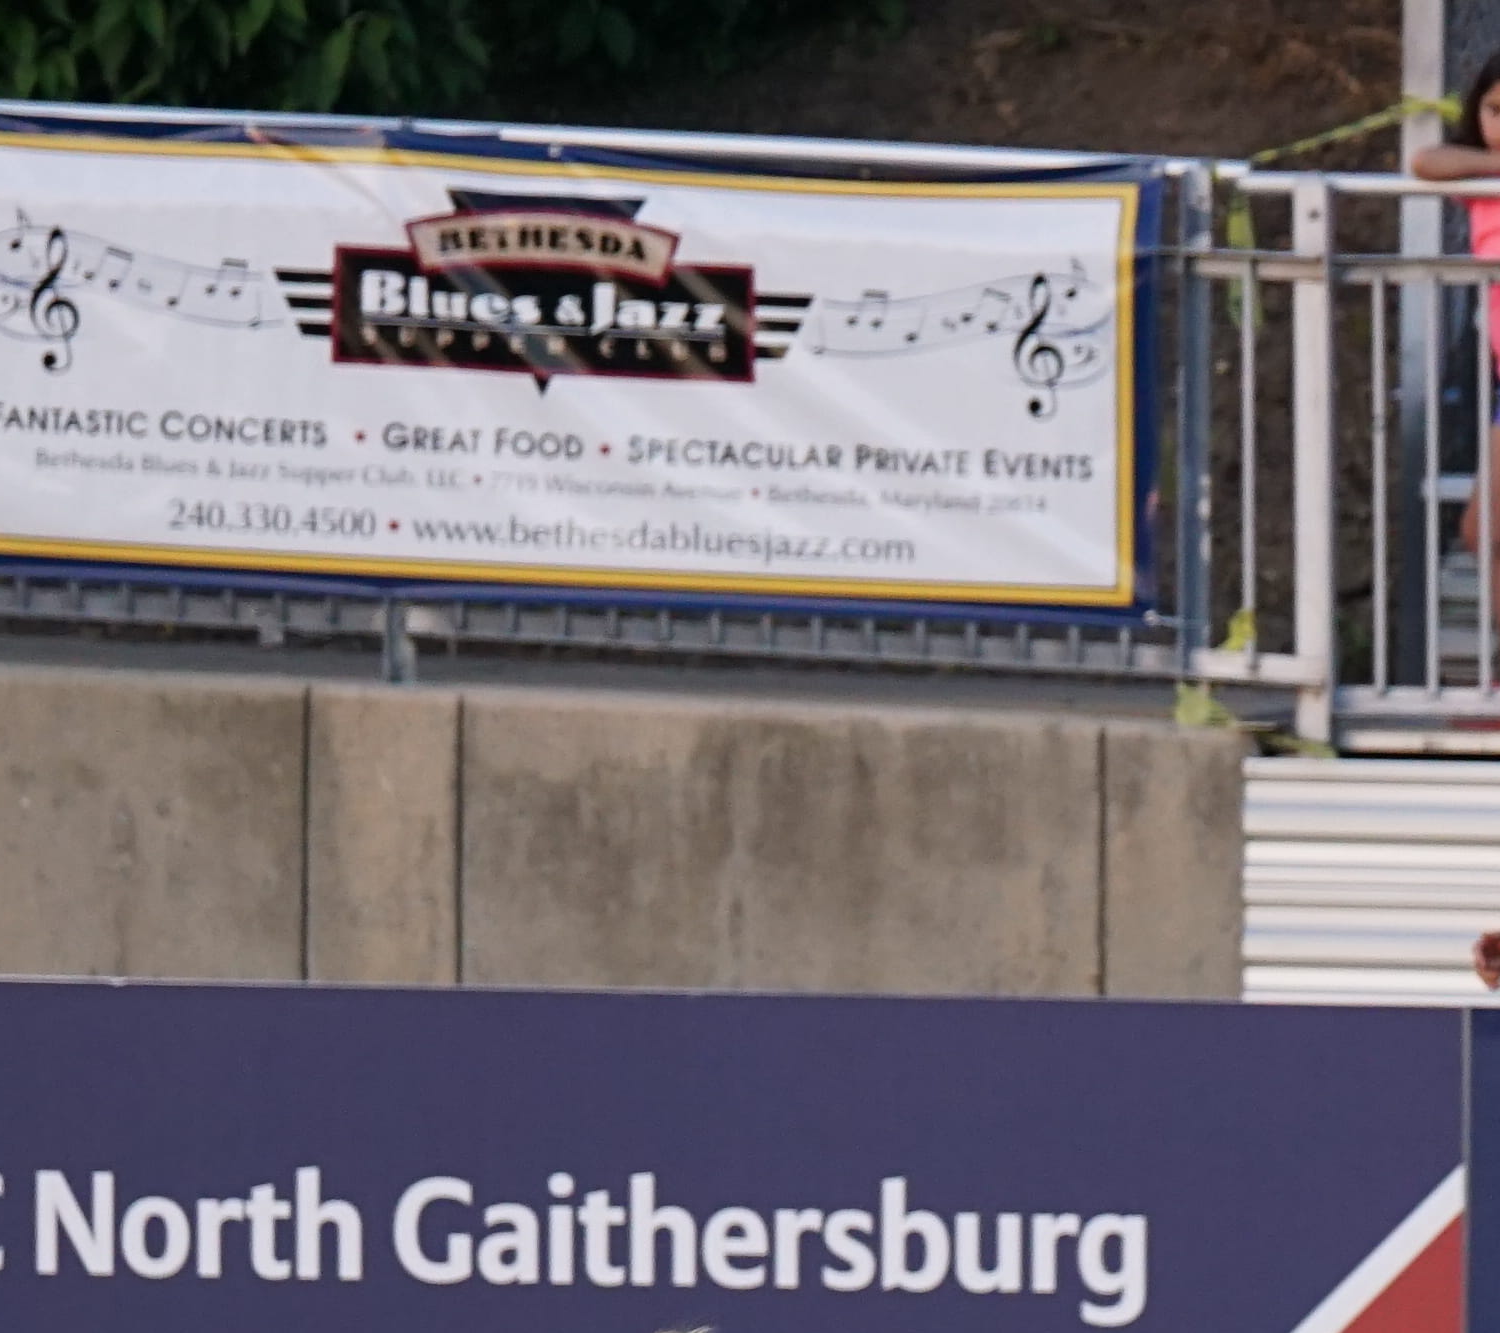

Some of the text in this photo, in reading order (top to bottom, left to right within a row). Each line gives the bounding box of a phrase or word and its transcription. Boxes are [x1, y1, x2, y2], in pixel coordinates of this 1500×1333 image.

[439, 225, 647, 262] BETHESDA
[361, 268, 726, 335] Blues & Jazz
[160, 410, 328, 447] CONCERTS
[382, 421, 482, 455] GREAT
[494, 424, 584, 461] FOOD
[627, 435, 842, 471] SPECTACULAR
[855, 442, 970, 476] PRIVATE
[983, 447, 1094, 481] EVENTS
[412, 511, 916, 563] www.bethesdabluesjazz.com
[34, 1165, 364, 1284] North
[392, 1172, 1149, 1329] Gaithersburg
